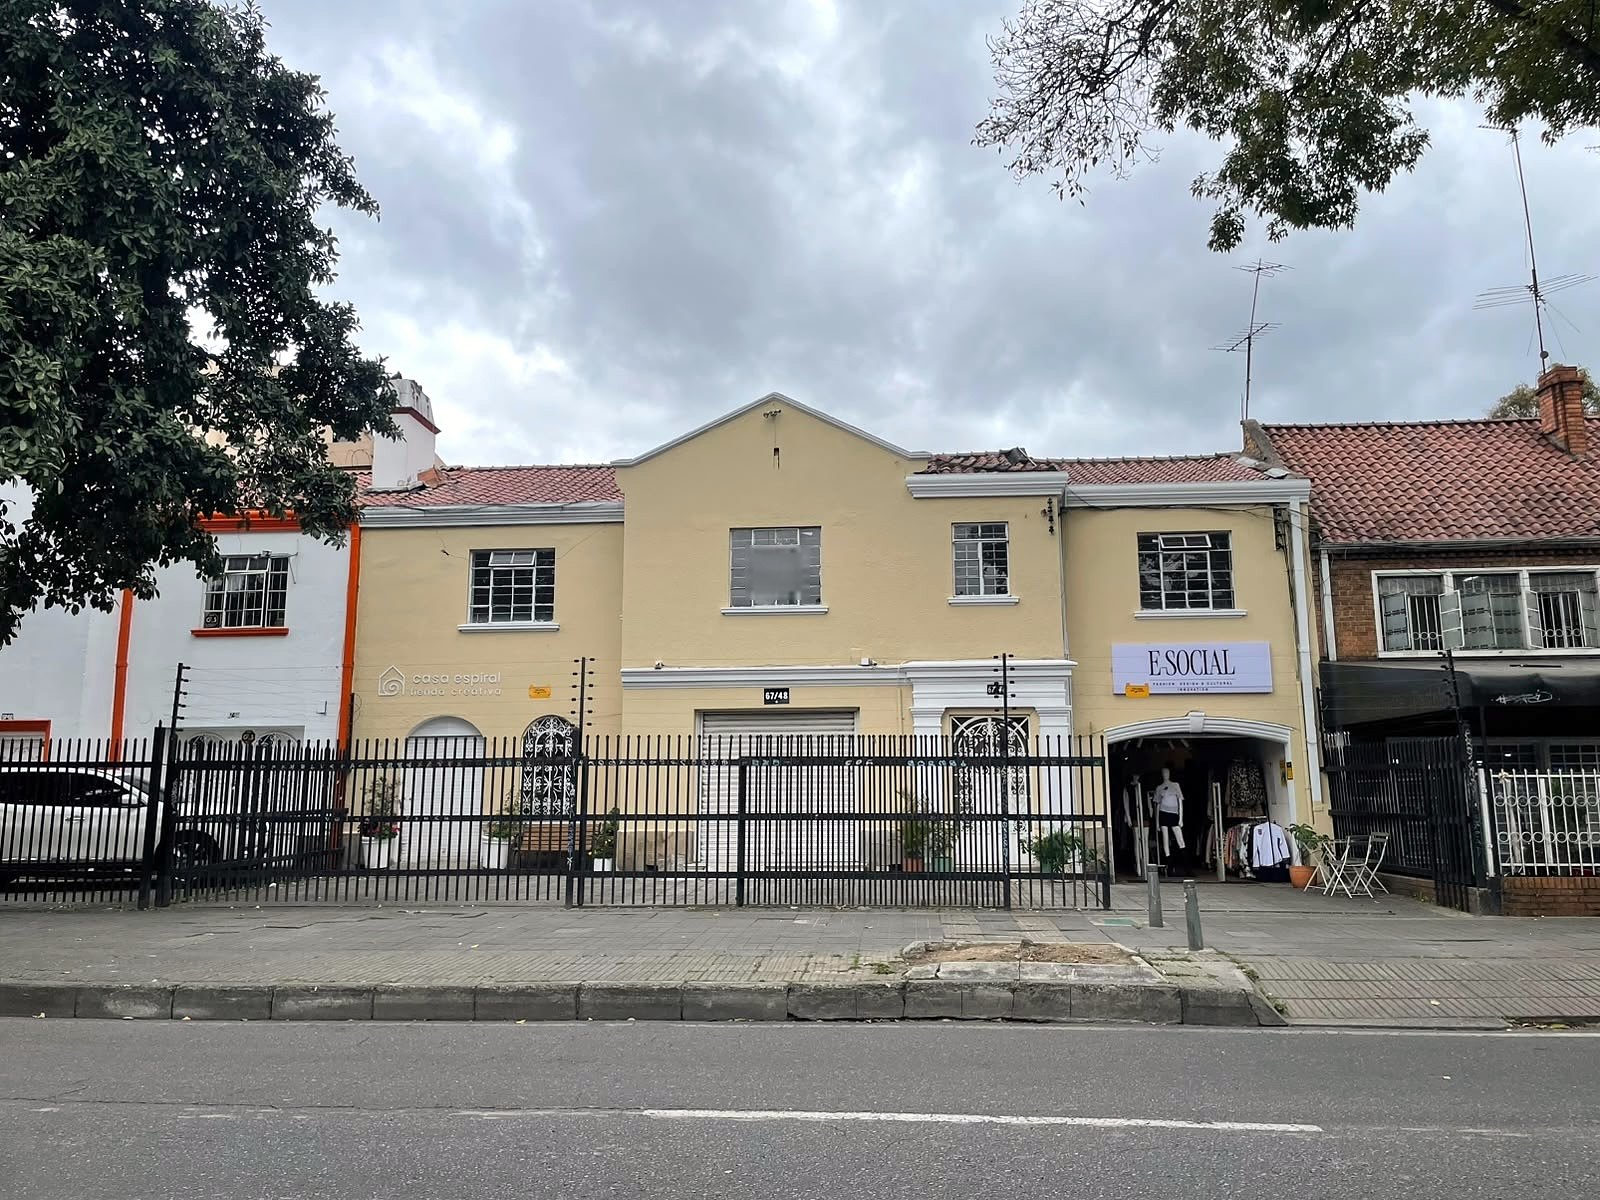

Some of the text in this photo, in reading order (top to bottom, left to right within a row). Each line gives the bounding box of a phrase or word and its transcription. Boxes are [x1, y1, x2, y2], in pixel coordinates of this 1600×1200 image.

[412, 672, 501, 687] casa espiral
[410, 687, 502, 697] tienda creativa
[765, 691, 789, 700] 67/48
